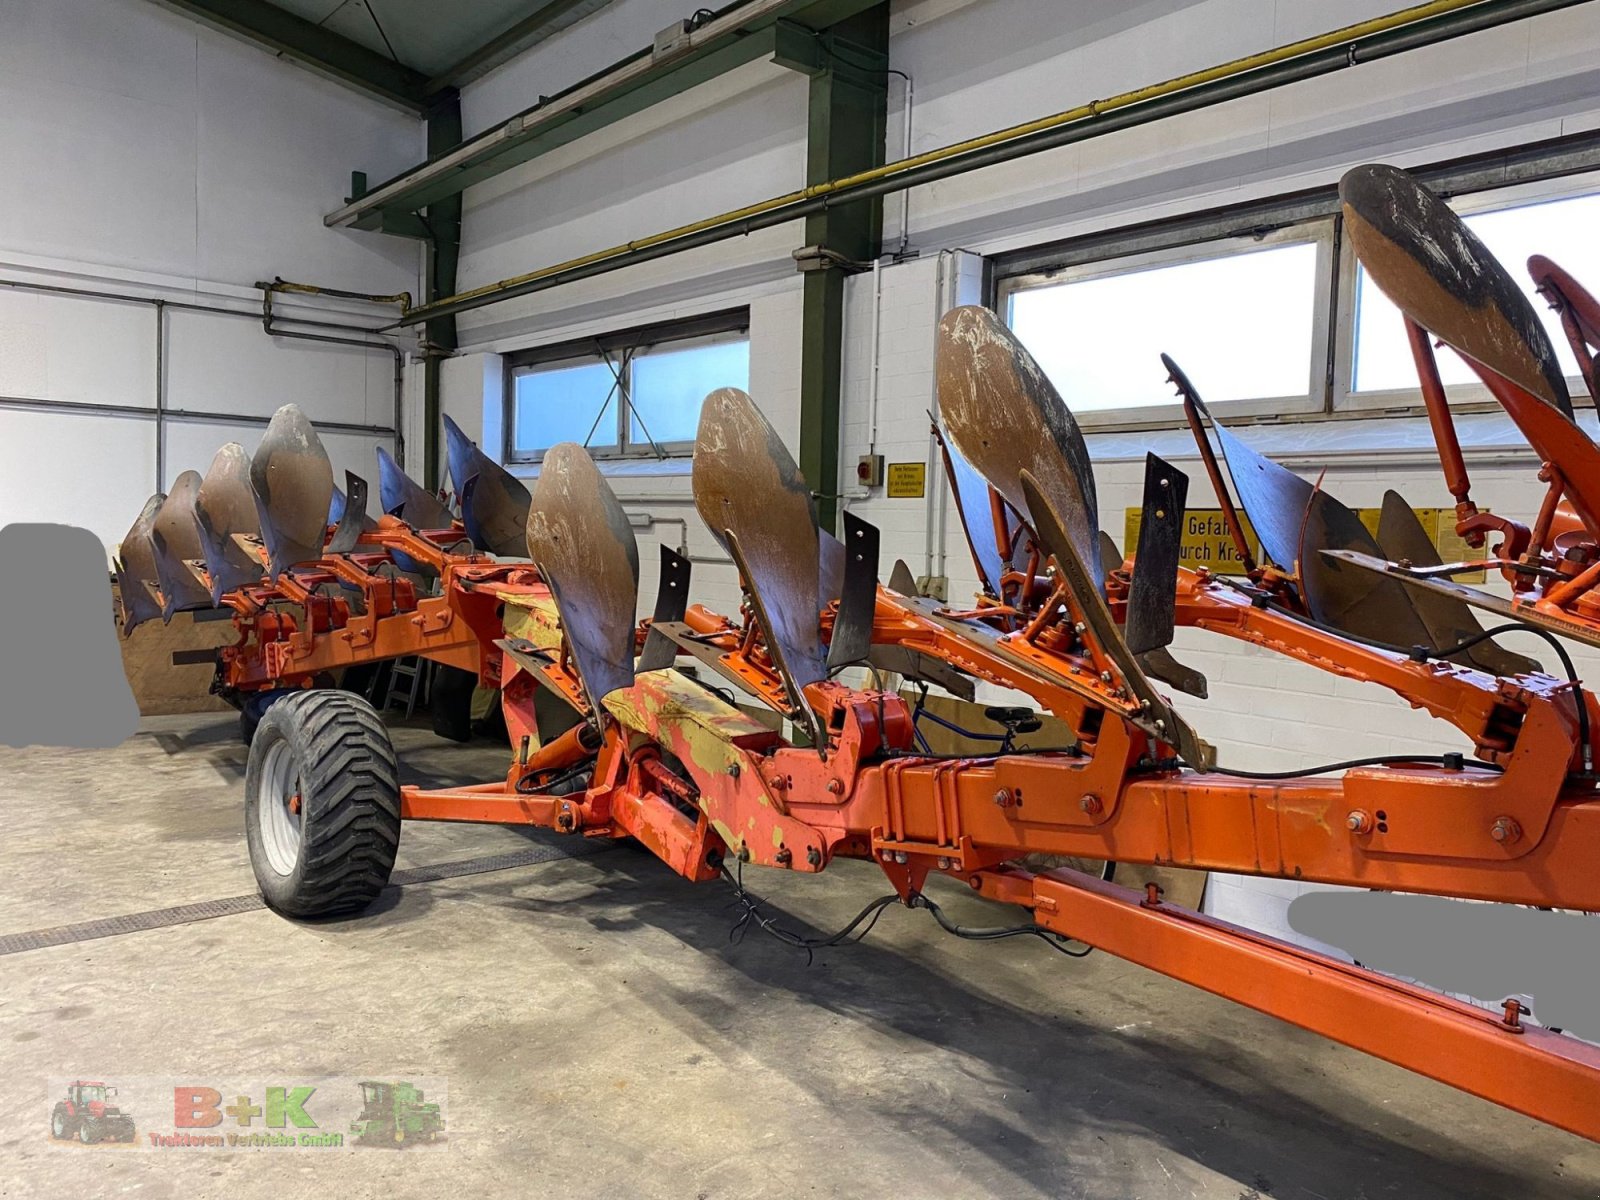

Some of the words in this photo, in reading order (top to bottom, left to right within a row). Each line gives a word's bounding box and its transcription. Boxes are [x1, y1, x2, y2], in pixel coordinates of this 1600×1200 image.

[1188, 516, 1231, 536] Gefah
[1179, 542, 1211, 561] urch
[1218, 542, 1250, 562] Kra
